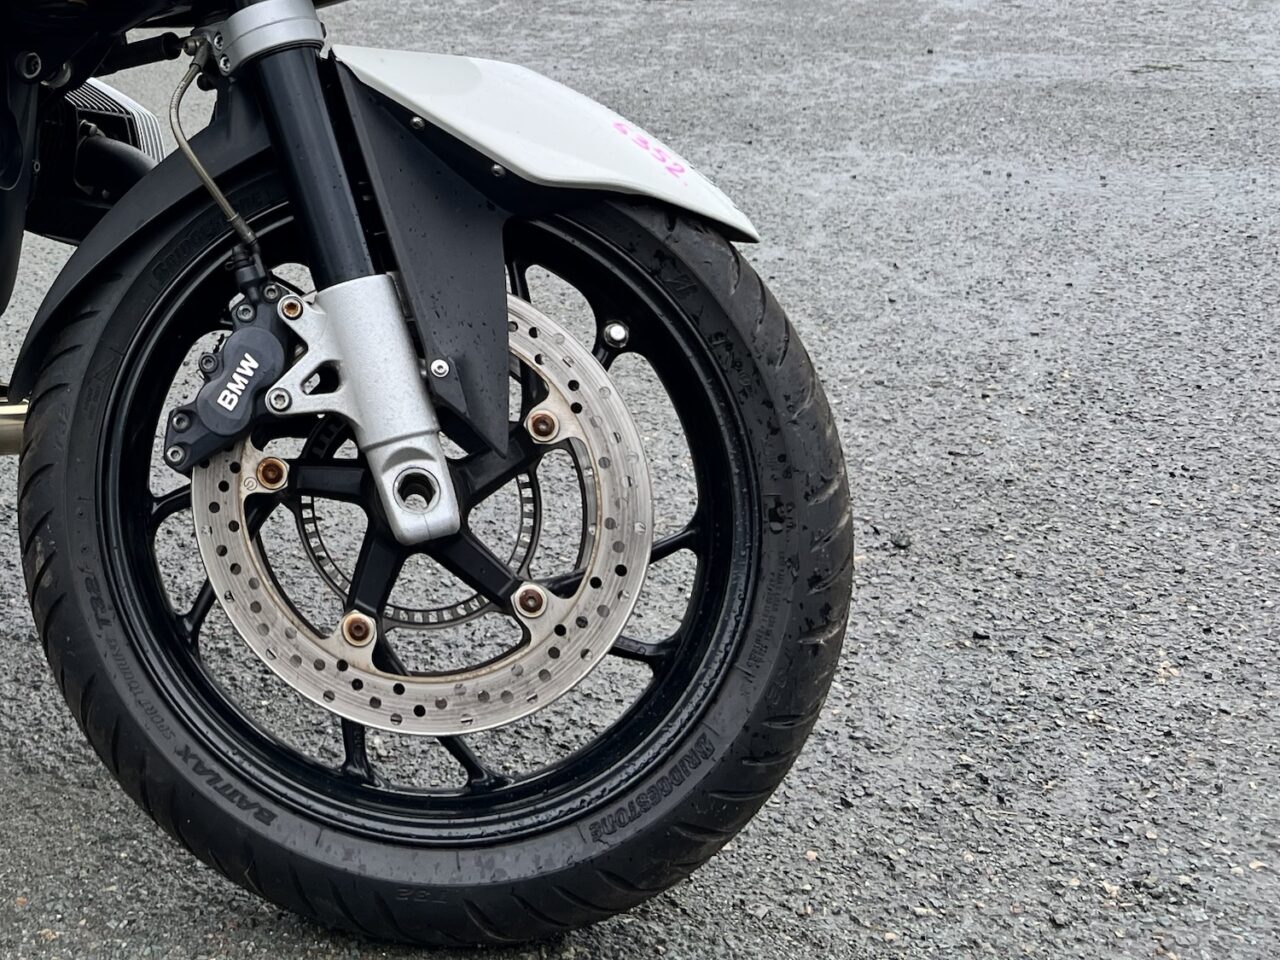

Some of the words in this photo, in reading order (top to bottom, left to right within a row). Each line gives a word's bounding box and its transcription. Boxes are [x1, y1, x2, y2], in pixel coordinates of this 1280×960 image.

[216, 352, 260, 412] BMW
[84, 575, 112, 631] T32
[588, 731, 716, 843] BRIDGESTONE
